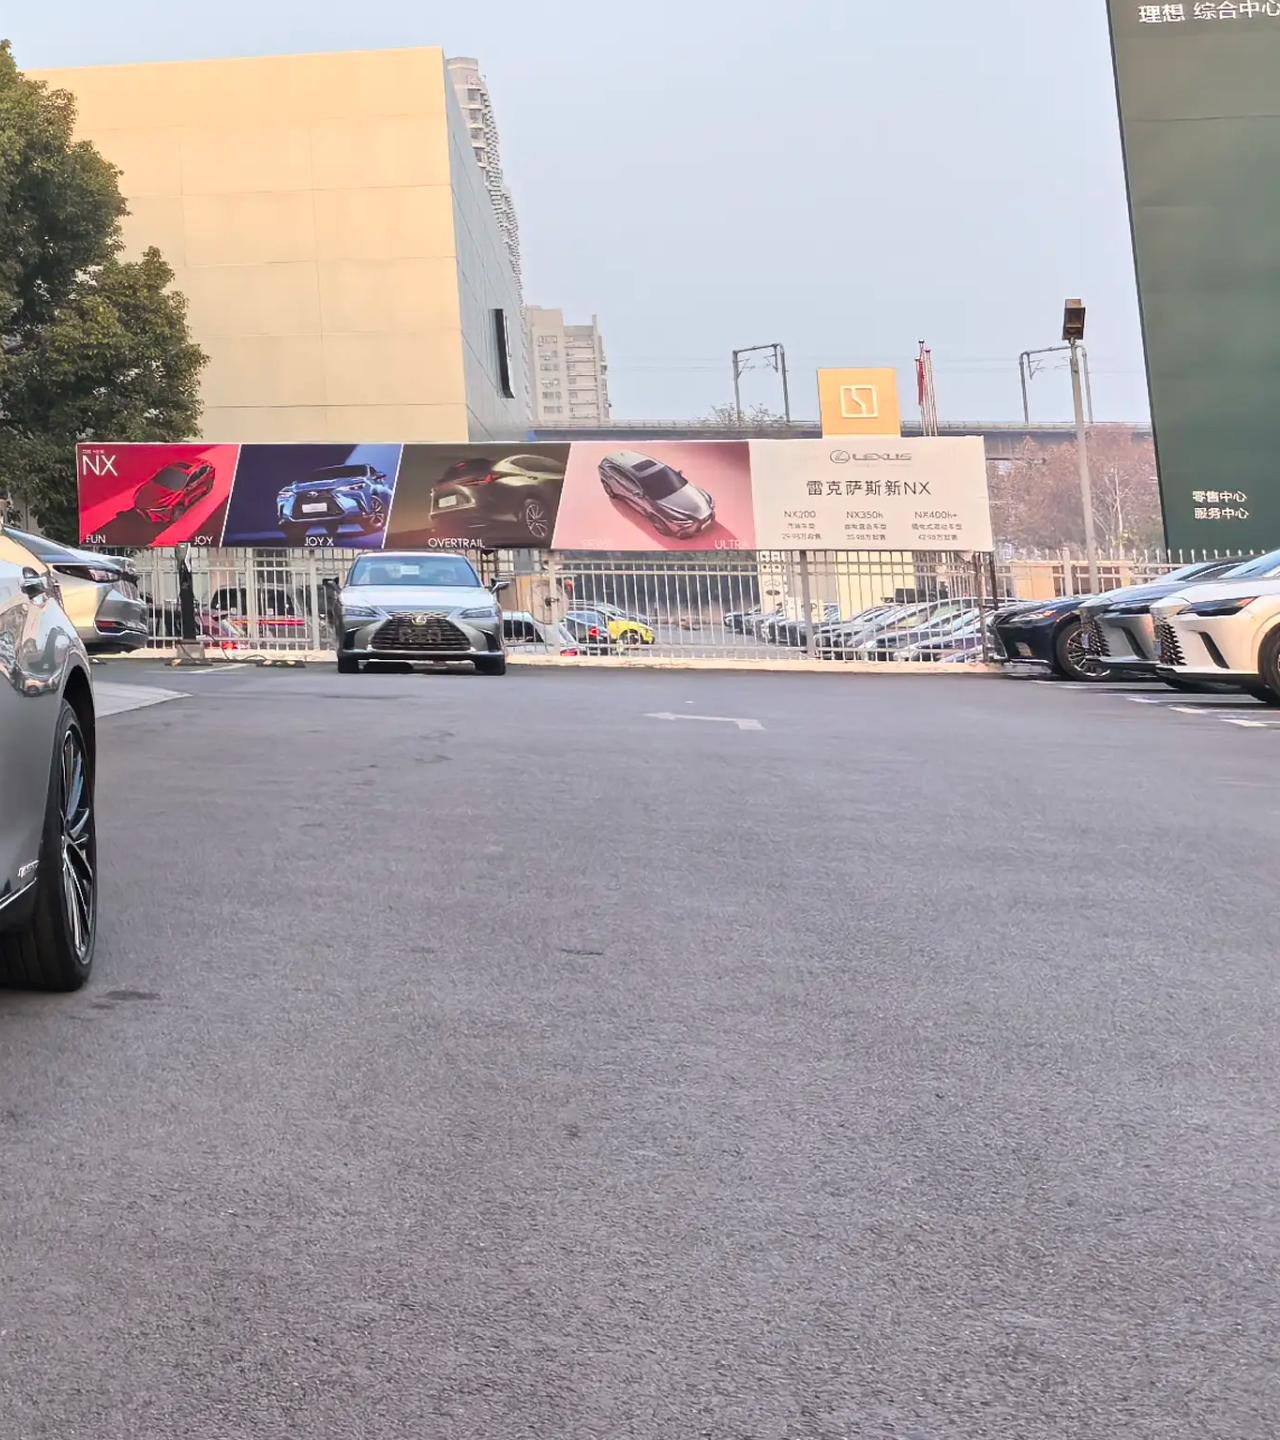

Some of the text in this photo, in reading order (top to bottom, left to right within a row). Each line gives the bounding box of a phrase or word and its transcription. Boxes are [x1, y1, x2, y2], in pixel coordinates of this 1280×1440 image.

[1138, 3, 1186, 23] 理想
[852, 452, 913, 462] LEXUS
[82, 455, 118, 476] NX
[806, 480, 932, 496] 雷克萨斯新NX
[1192, 491, 1247, 503] 零售中心
[1194, 508, 1249, 520] 服务中心
[85, 534, 214, 545] FUN JOY
[304, 536, 335, 547] JOY X
[428, 538, 486, 549] OVERTRAIL
[715, 540, 747, 549] ULTR
